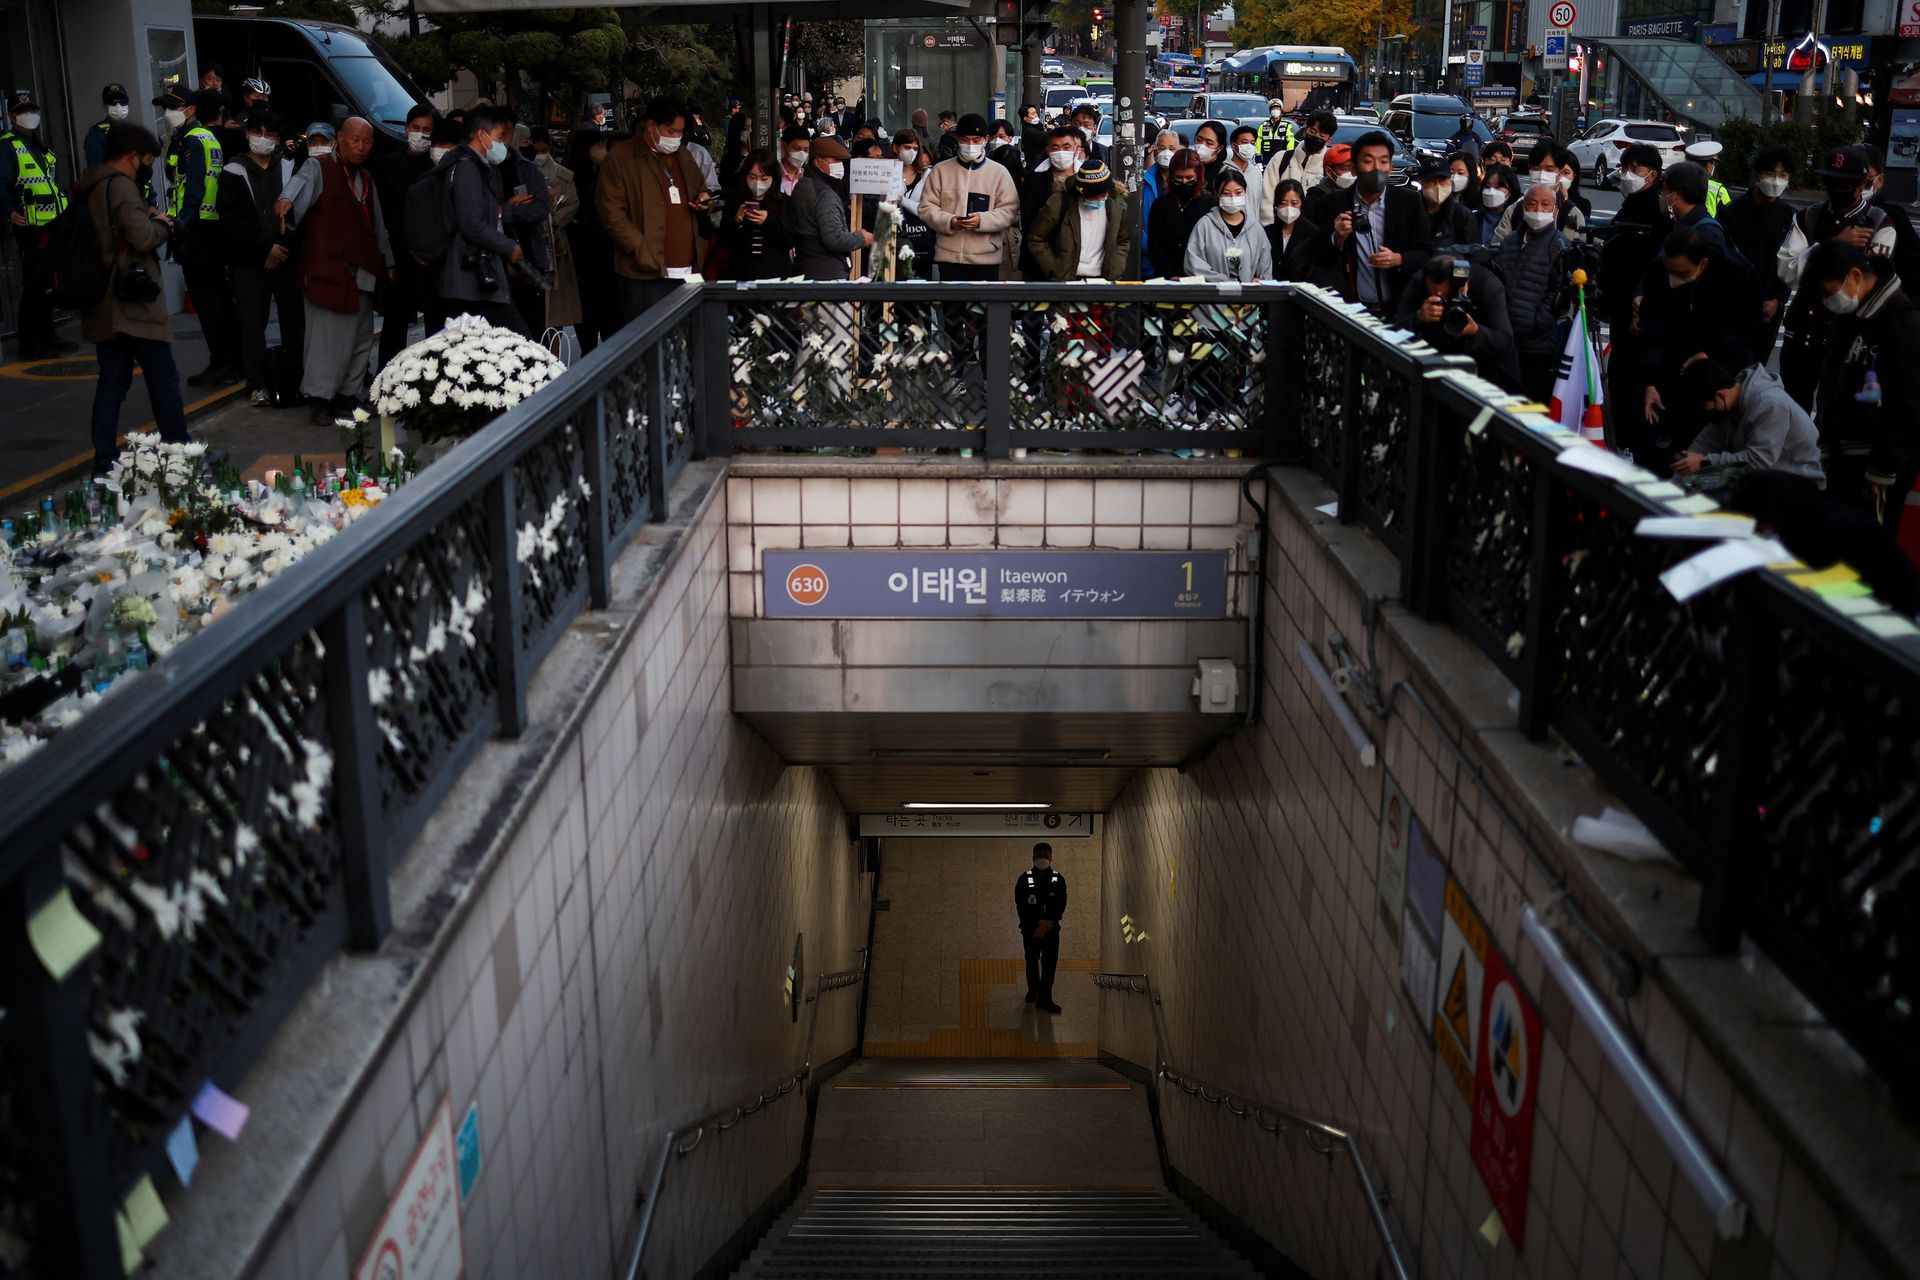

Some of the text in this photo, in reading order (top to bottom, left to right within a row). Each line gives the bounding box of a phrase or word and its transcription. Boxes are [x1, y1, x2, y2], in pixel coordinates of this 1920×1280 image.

[1555, 8, 1570, 22] 50
[1628, 21, 1683, 36] PARIS BAGUETTE
[946, 34, 967, 43] 이태원
[1437, 79, 1445, 90] P
[758, 124, 769, 147] 중심
[999, 568, 1068, 585] Itaewon
[1181, 561, 1193, 592] 1
[791, 576, 824, 593] 630
[888, 566, 988, 606] 이태원
[1000, 588, 1047, 604] 梨泰院
[1059, 589, 1126, 604] イテウォン
[1177, 593, 1200, 602] 출입구
[886, 815, 911, 827] 타는
[1047, 815, 1057, 825] 6
